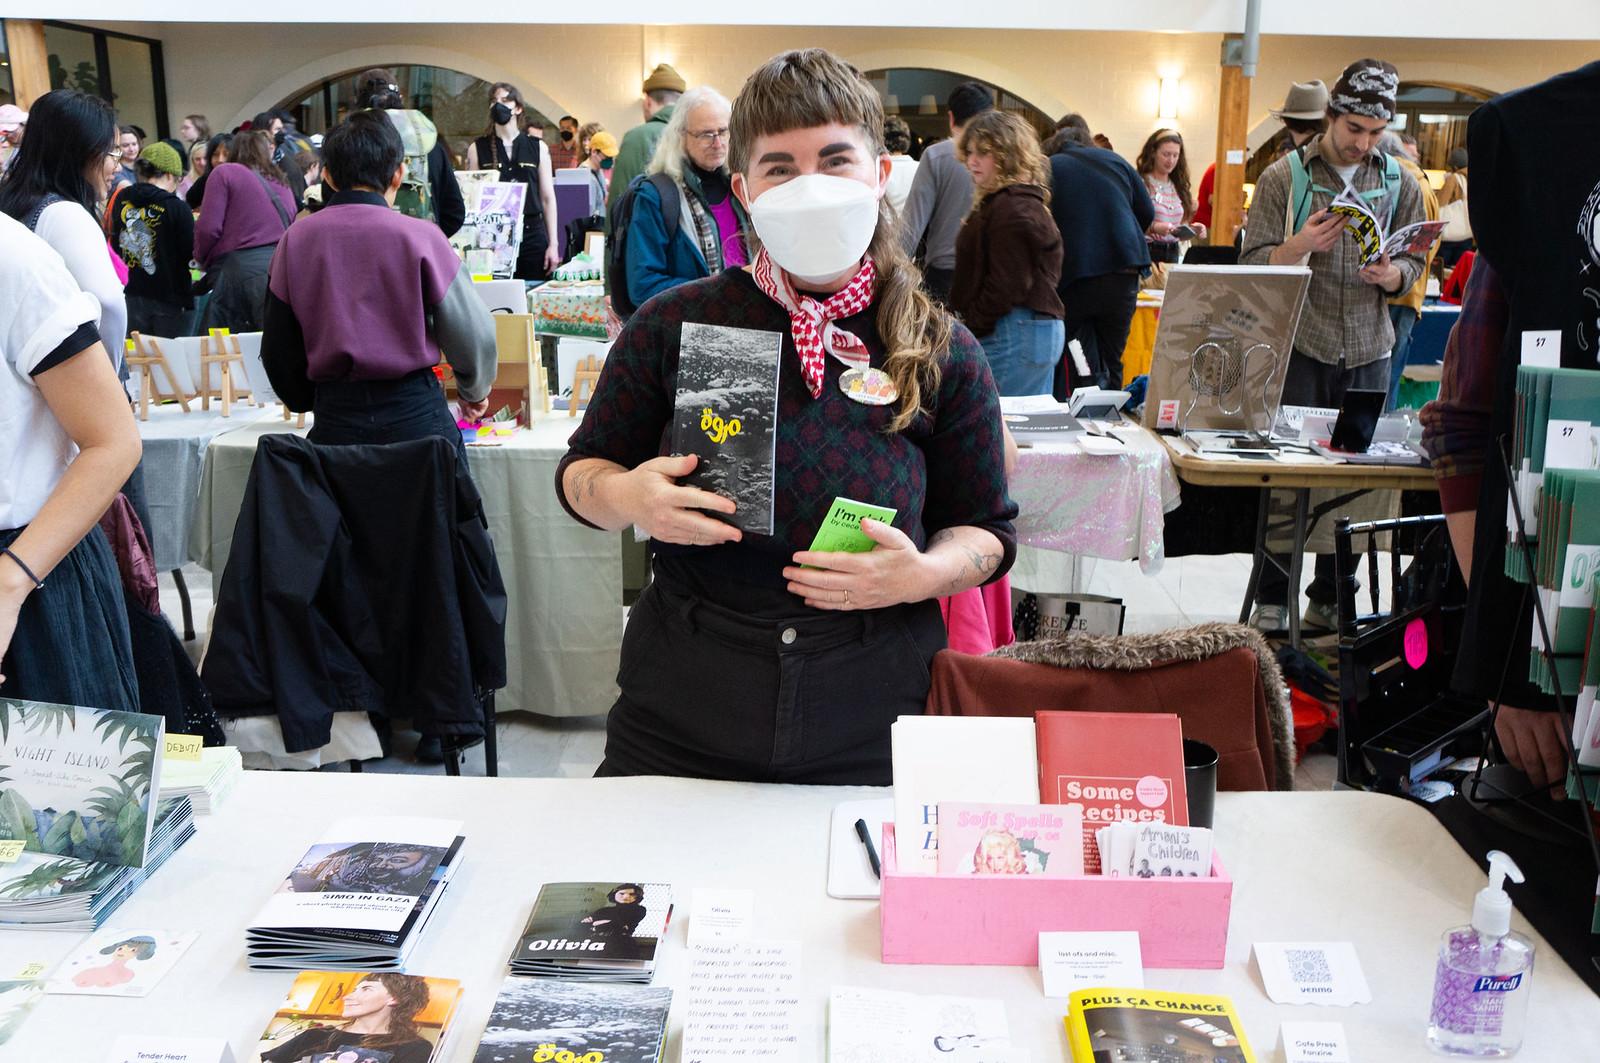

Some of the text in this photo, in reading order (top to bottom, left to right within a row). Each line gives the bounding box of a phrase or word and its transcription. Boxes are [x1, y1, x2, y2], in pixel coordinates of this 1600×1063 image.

[700, 407, 741, 444] مروة
[834, 508, 856, 522] I'm
[830, 519, 840, 527] by
[14, 744, 110, 769] NIGHT ISLAND
[1066, 781, 1134, 800] Some
[957, 810, 1063, 831] Soft Spells
[1148, 844, 1200, 862] Children
[376, 895, 411, 903] GAZA
[528, 939, 606, 951] Olivia
[1479, 977, 1519, 990] Purell
[1081, 996, 1227, 1012] PLUS ÇA CHANGE
[137, 1051, 187, 1061] Tender Heart
